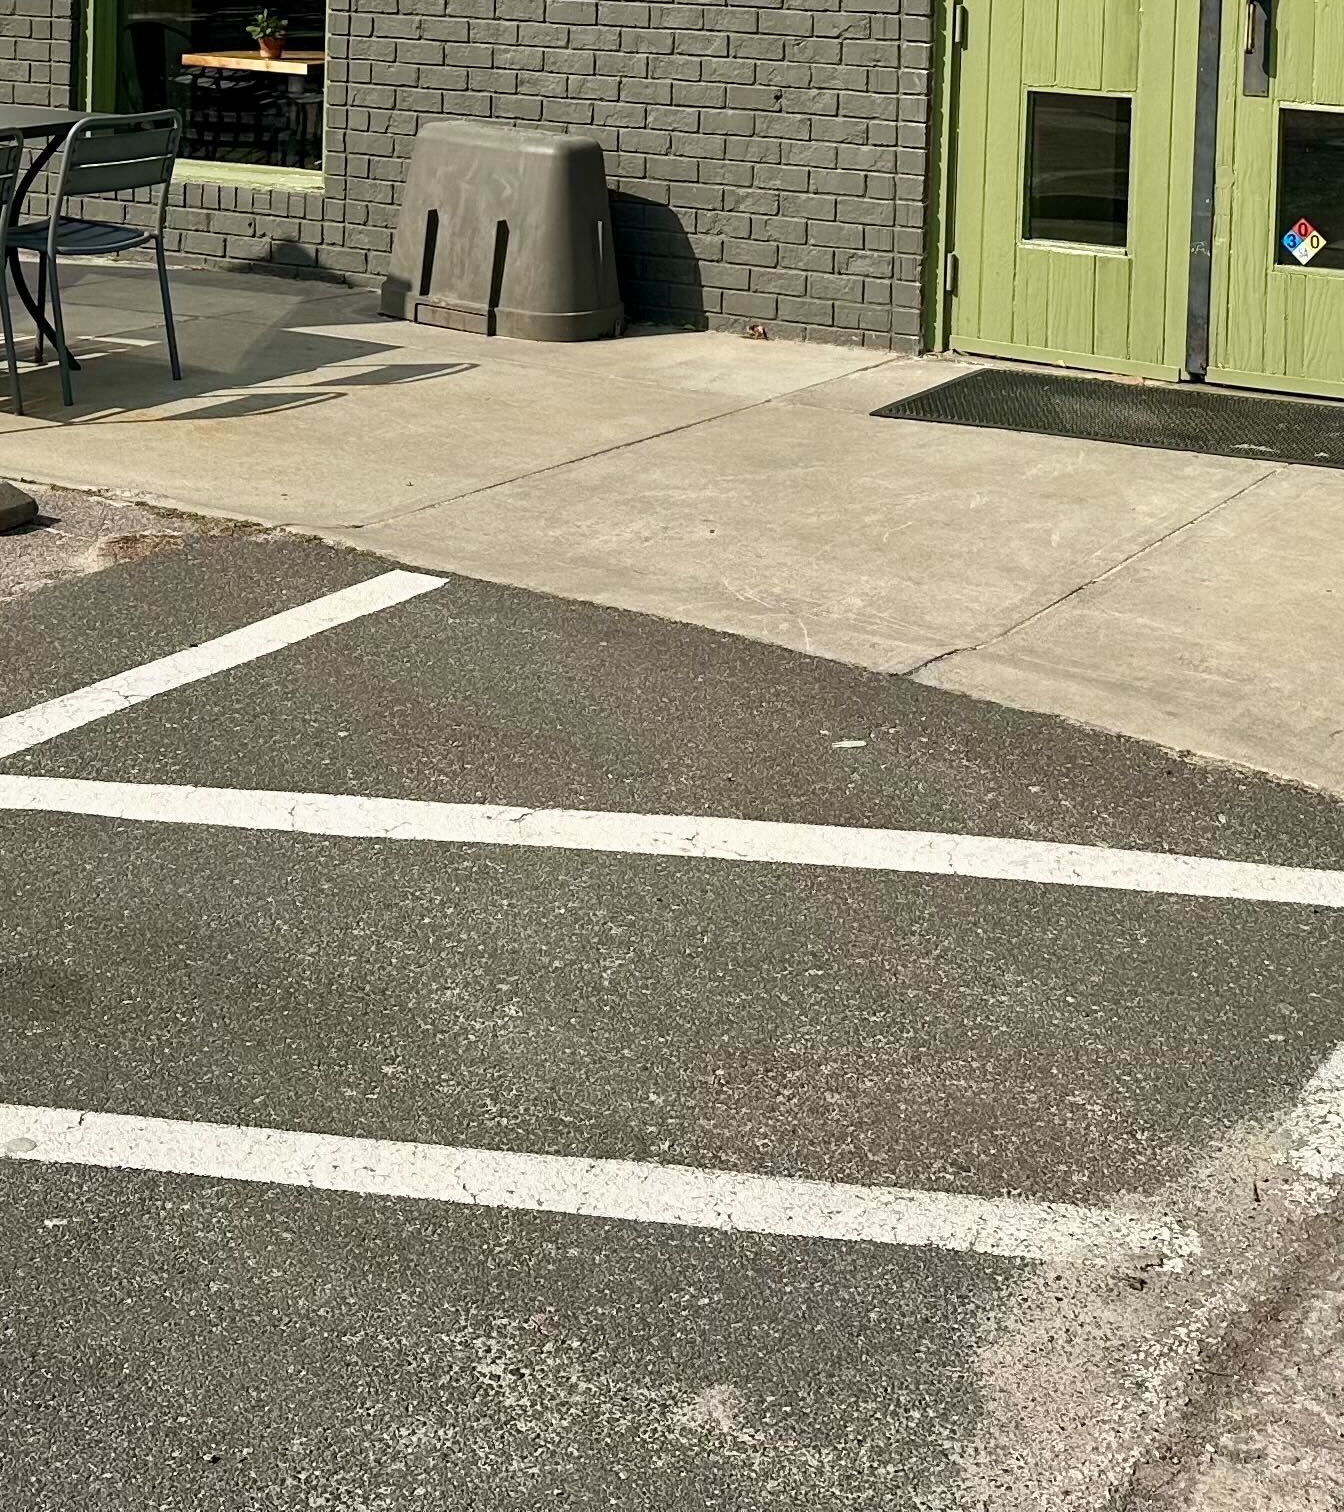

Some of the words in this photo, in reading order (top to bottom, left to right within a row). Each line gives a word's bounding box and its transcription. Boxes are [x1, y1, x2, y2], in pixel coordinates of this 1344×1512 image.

[1298, 222, 1308, 237] 0
[1286, 233, 1297, 249] 3
[1310, 234, 1320, 249] 0
